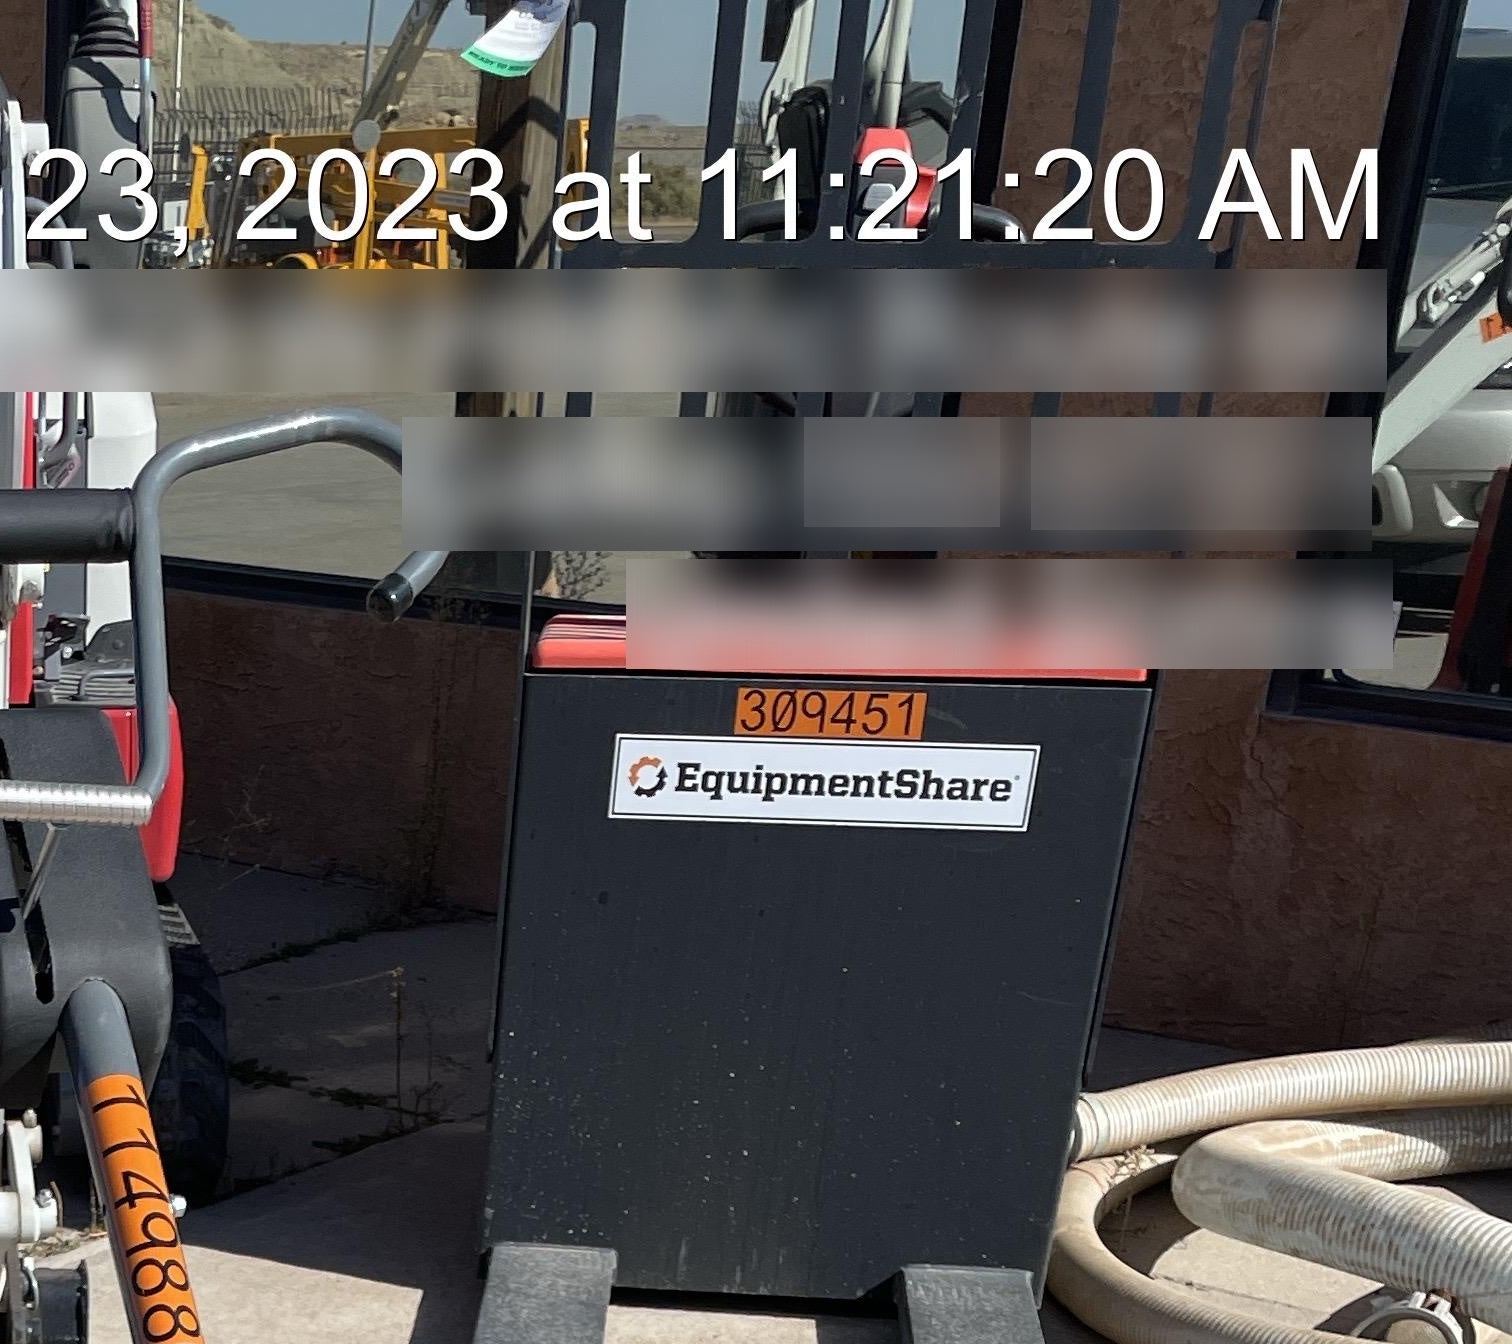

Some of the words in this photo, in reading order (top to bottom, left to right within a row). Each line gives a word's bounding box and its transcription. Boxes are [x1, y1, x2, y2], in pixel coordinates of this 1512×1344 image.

[740, 689, 915, 736] 309451
[674, 762, 1014, 802] EquipmentShare
[91, 1083, 201, 1344] 114988
